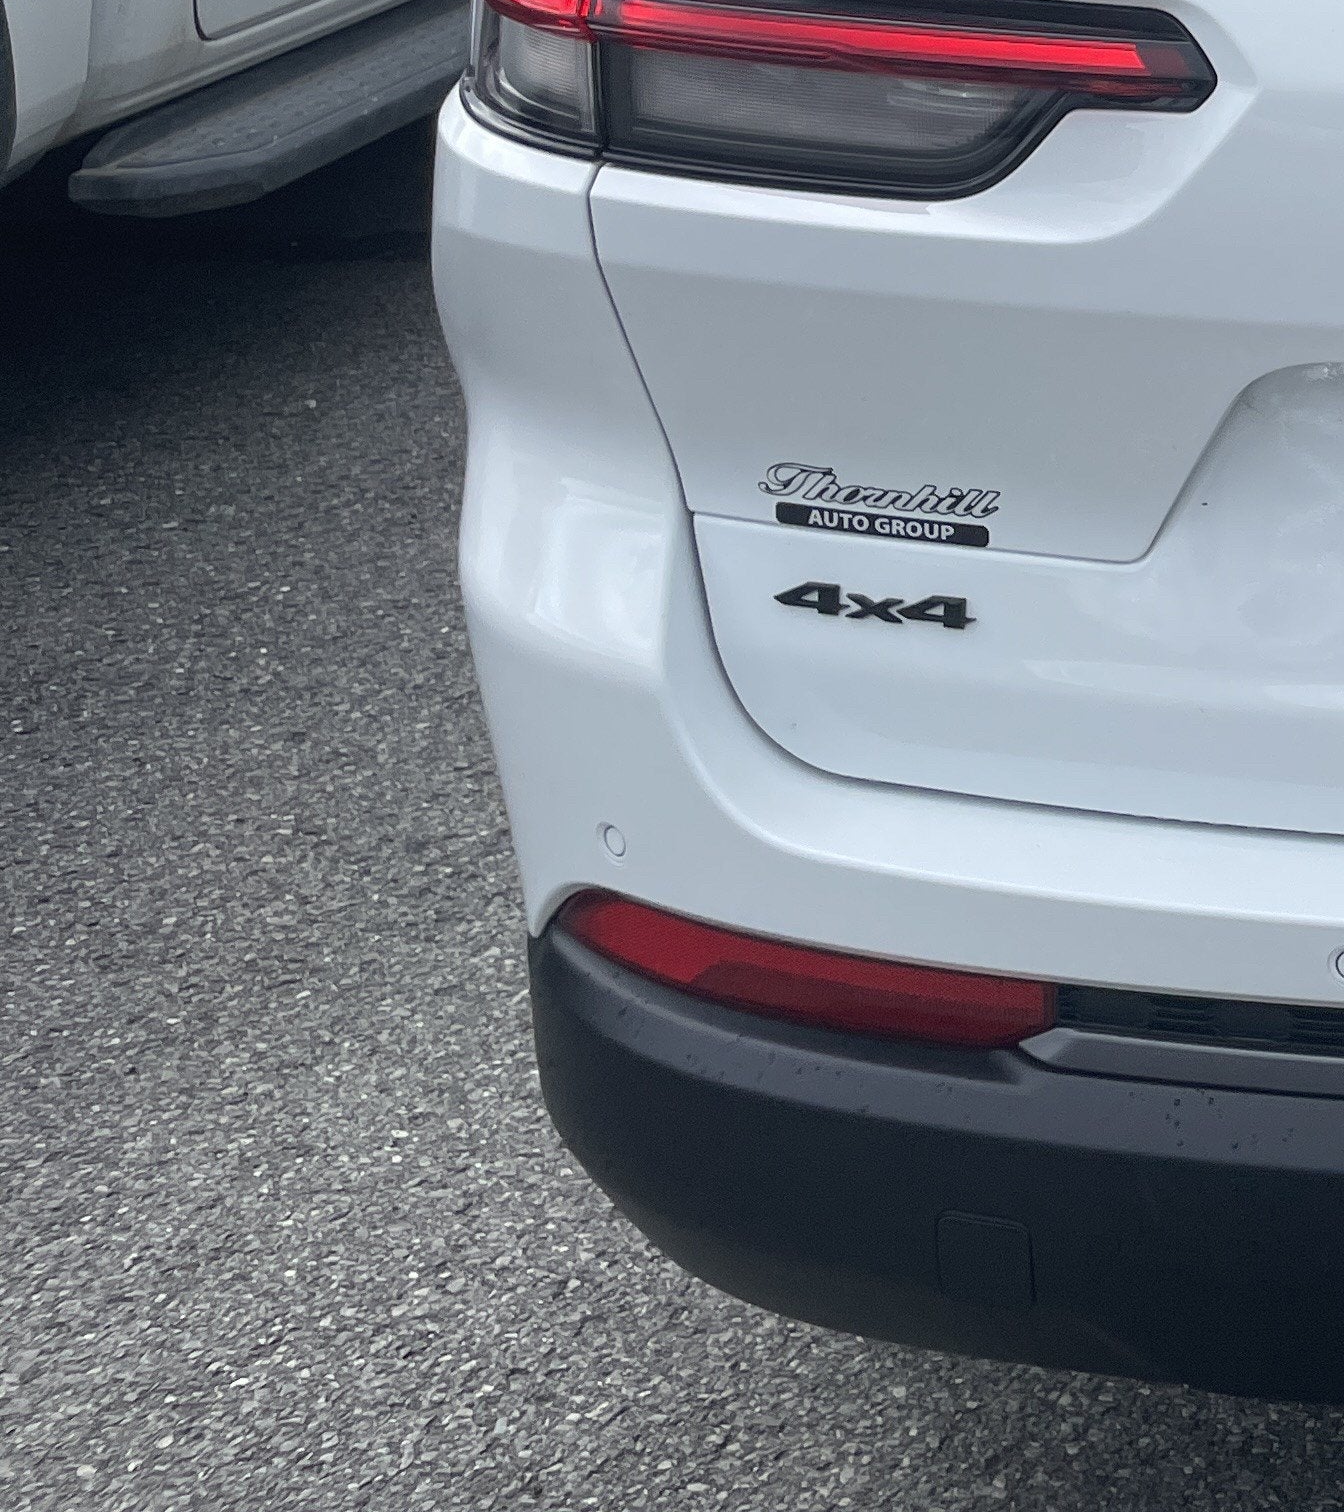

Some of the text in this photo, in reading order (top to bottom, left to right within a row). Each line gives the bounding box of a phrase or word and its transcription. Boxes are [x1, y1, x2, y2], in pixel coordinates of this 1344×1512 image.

[758, 462, 1001, 519] Thornhill
[807, 509, 955, 541] AUTO GROUP
[773, 580, 977, 630] 4x4
